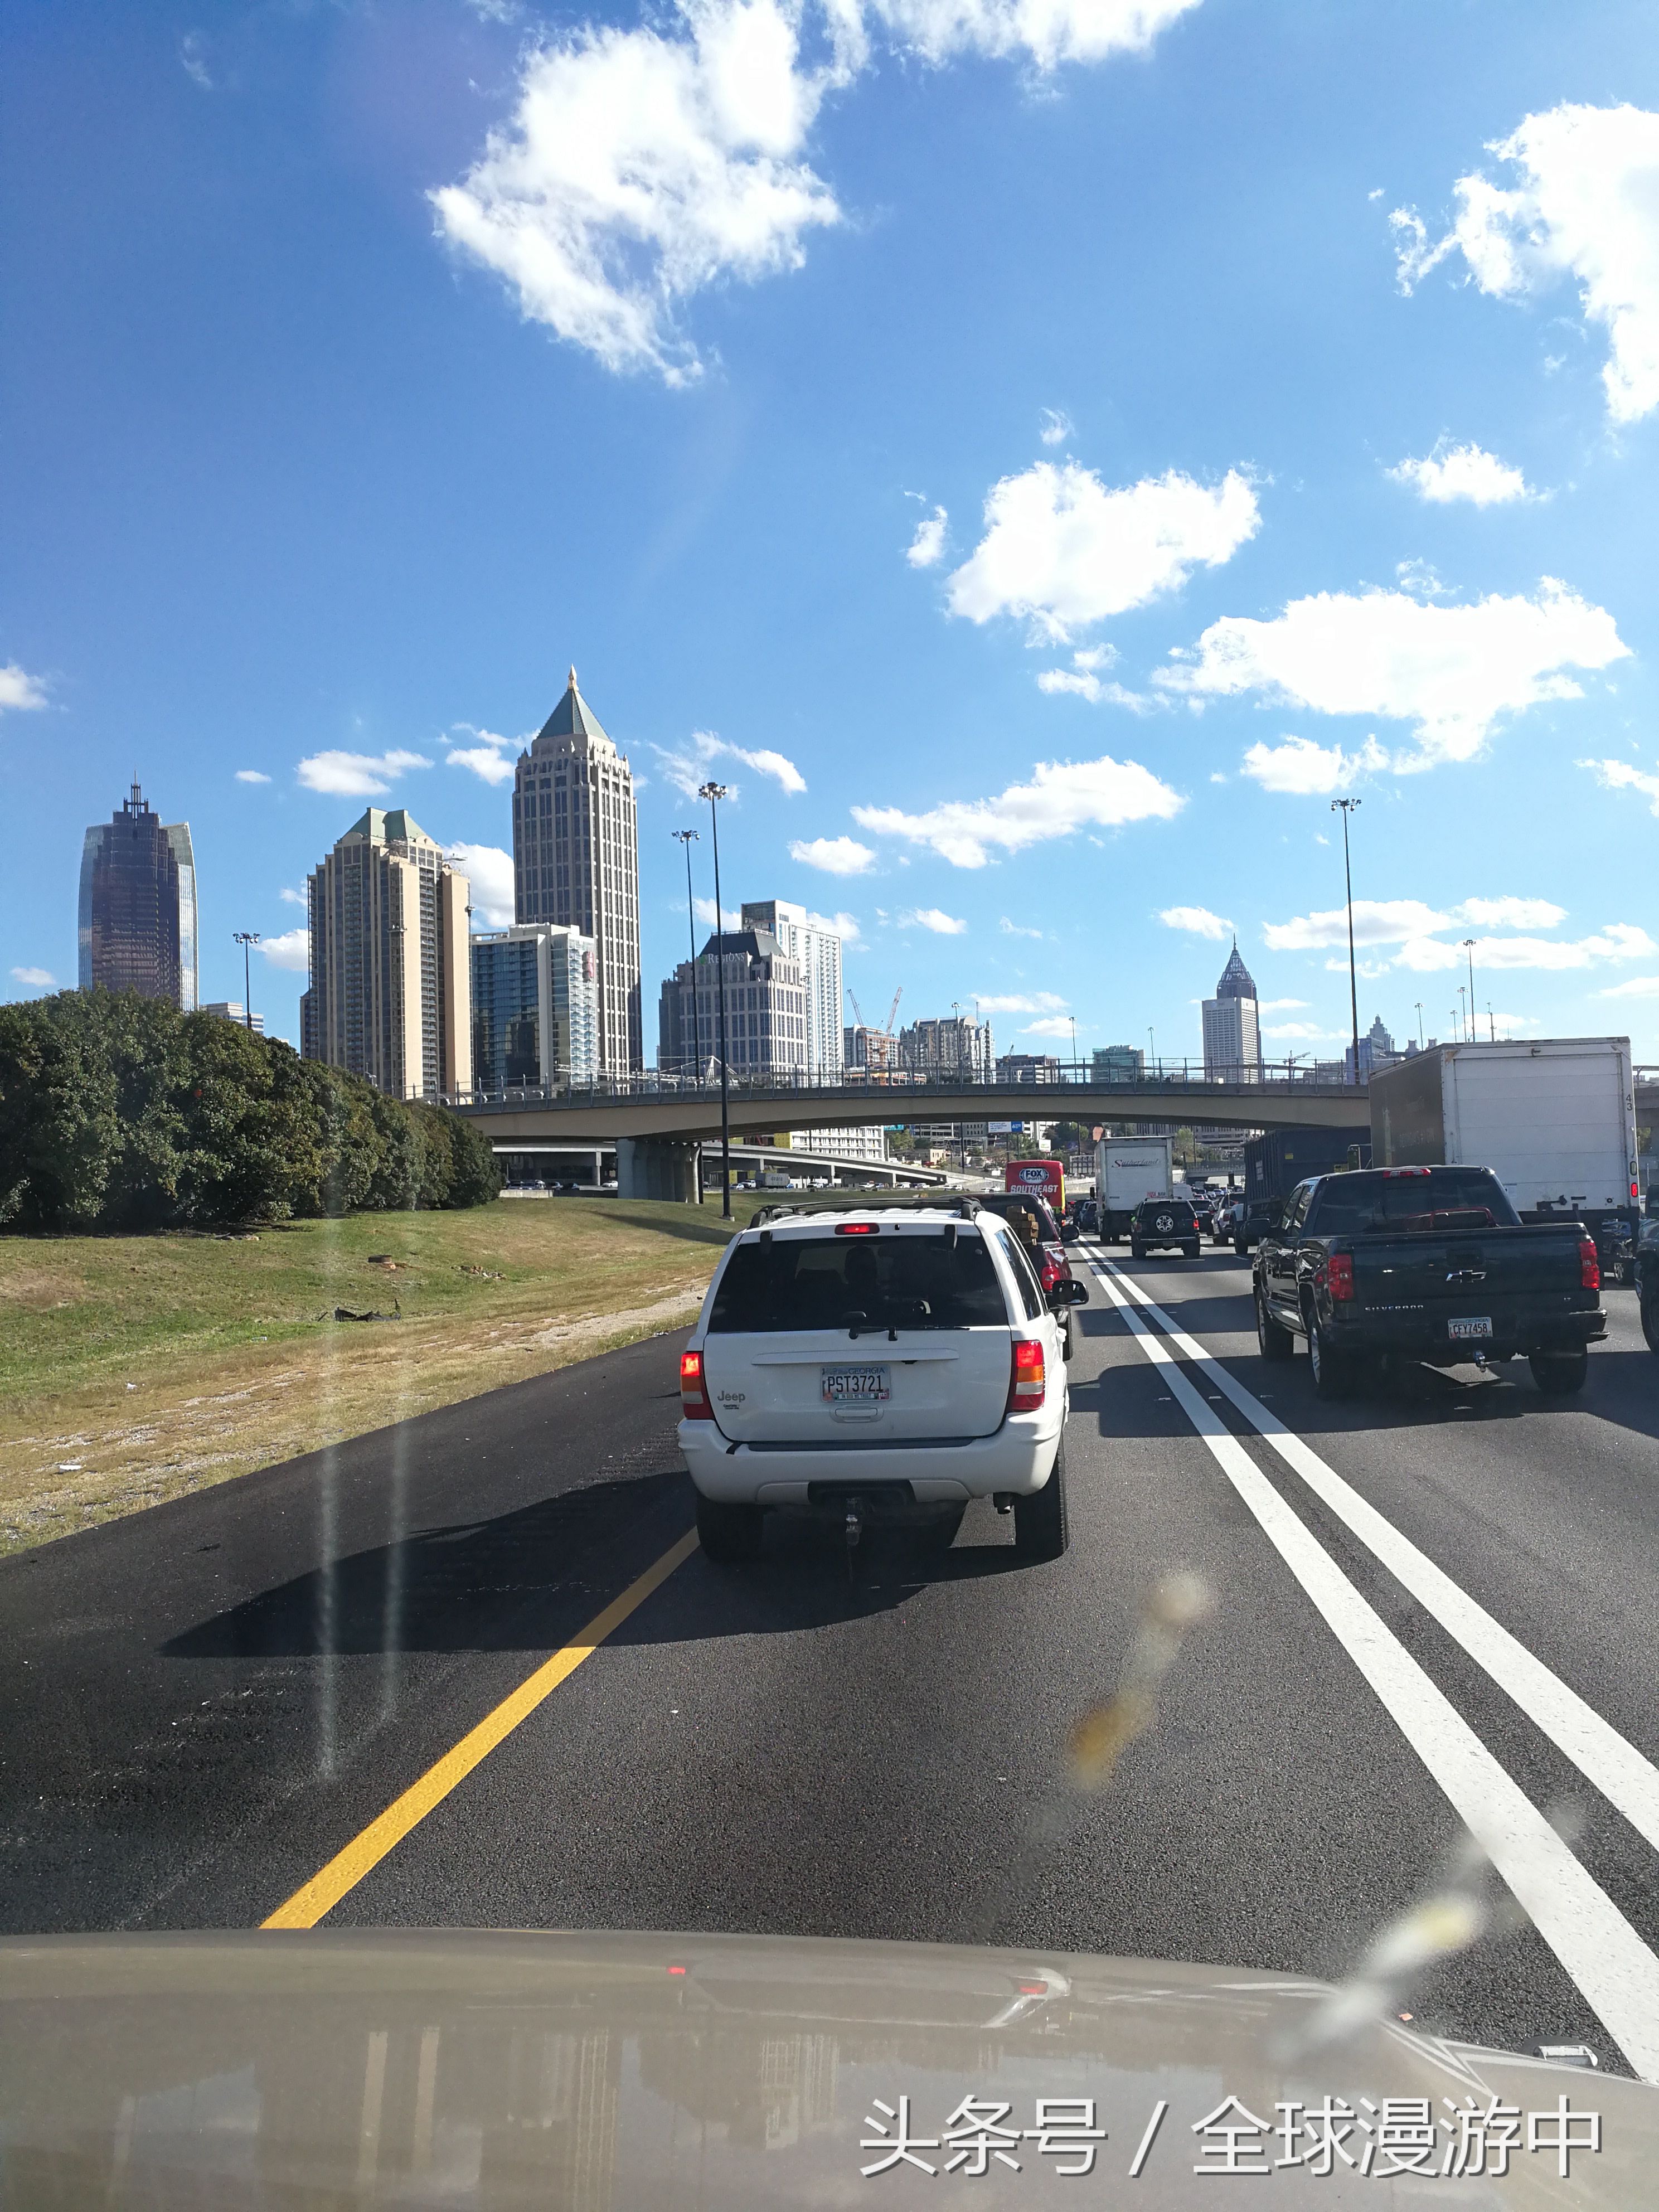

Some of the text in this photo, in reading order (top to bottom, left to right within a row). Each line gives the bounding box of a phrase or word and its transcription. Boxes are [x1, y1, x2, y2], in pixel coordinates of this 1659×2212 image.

[1010, 1185, 1059, 1194] SOUTHEAST
[1453, 1323, 1488, 1335] CFY7458
[827, 1375, 884, 1393] PST3721
[717, 1390, 746, 1403] Jeep
